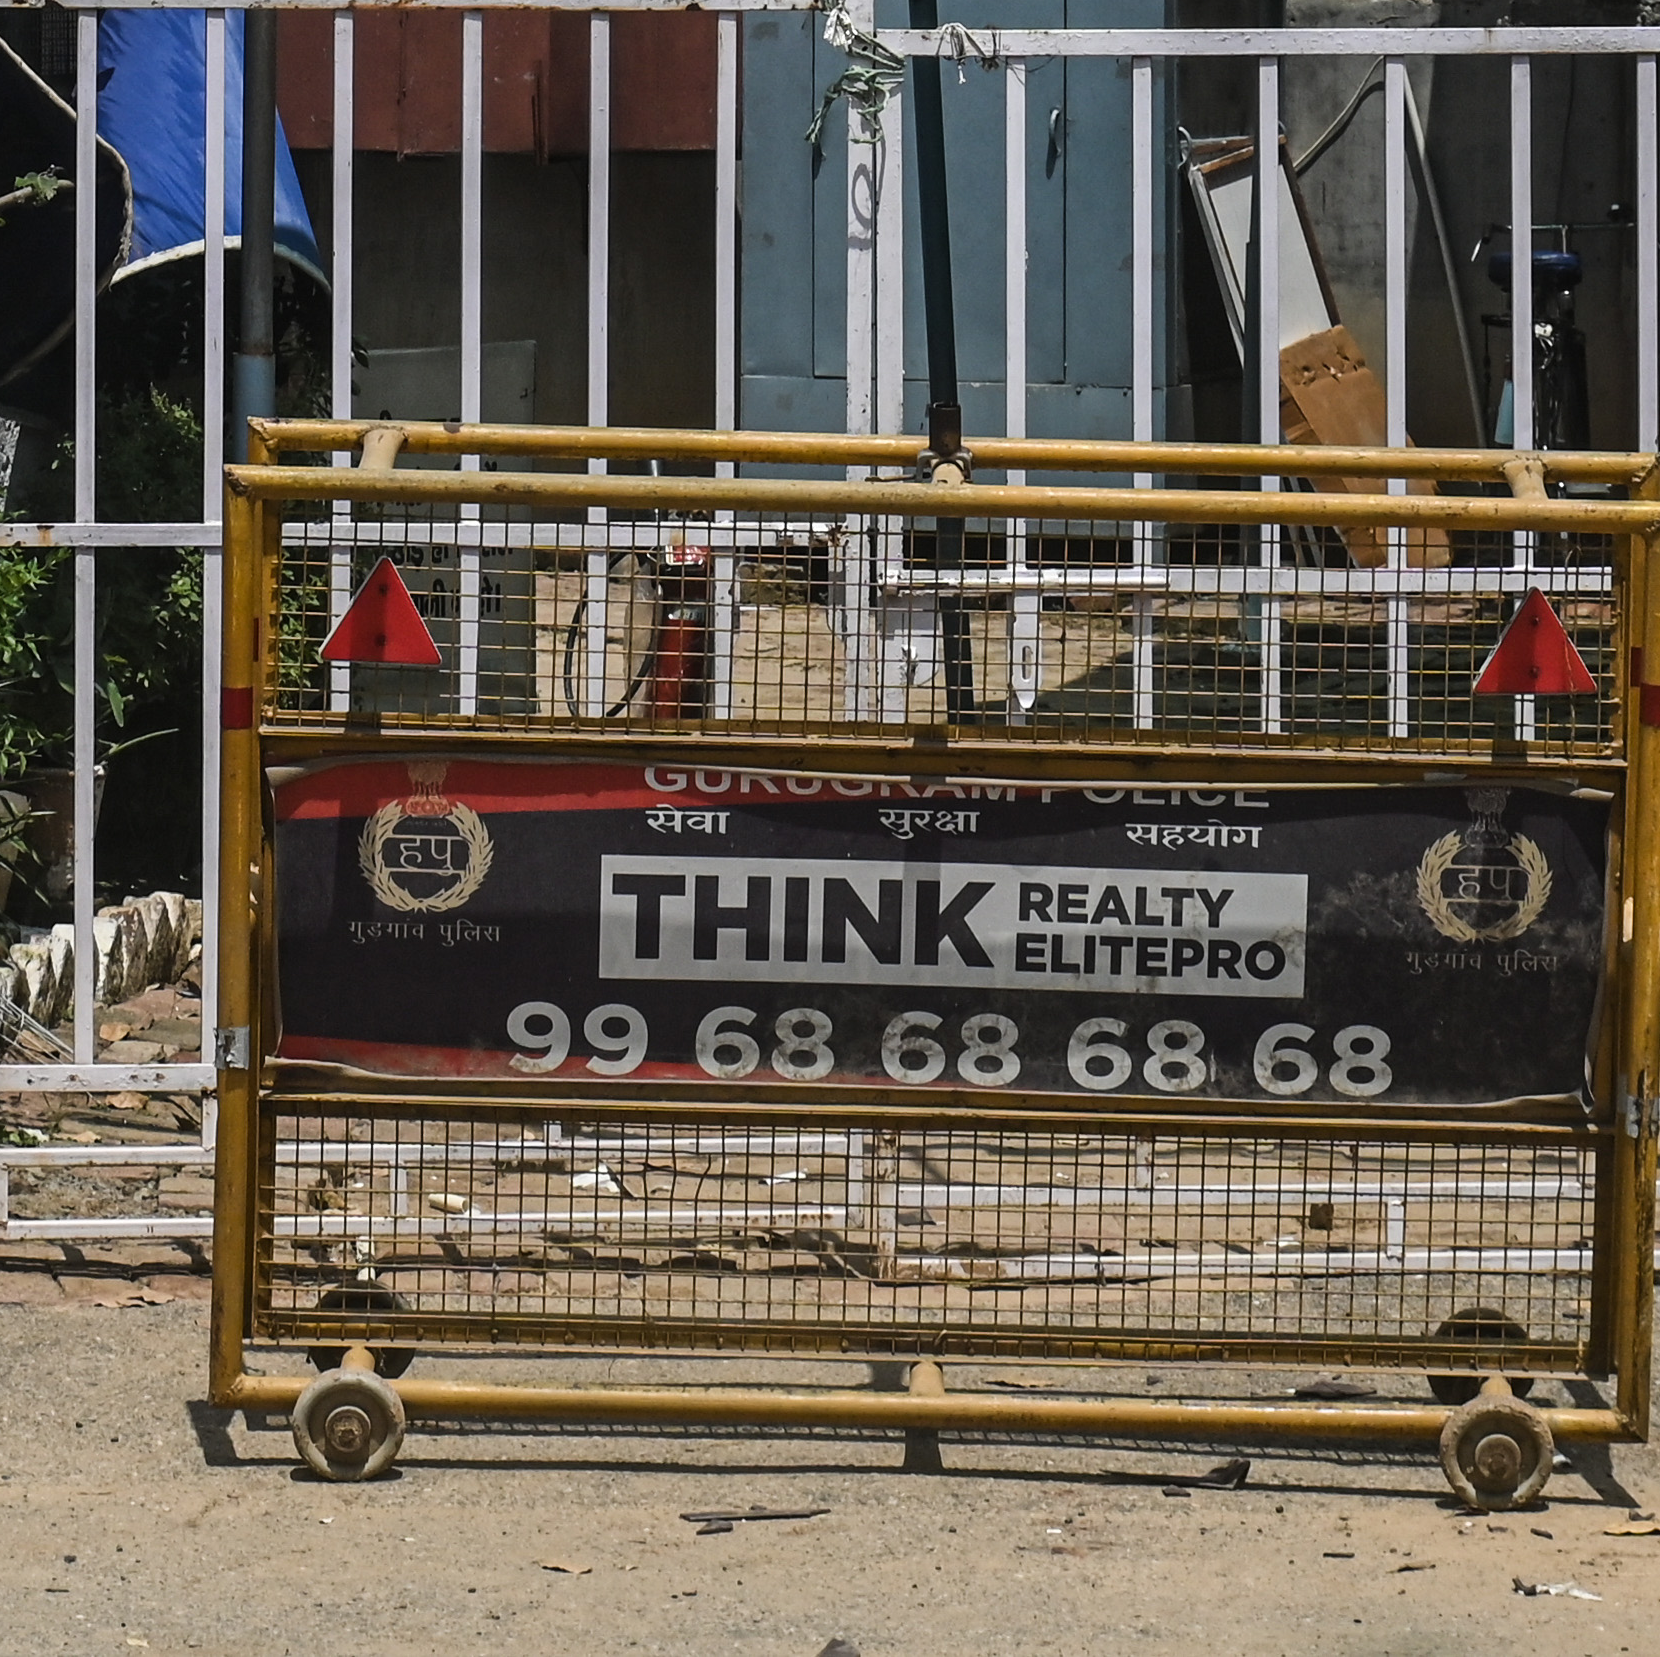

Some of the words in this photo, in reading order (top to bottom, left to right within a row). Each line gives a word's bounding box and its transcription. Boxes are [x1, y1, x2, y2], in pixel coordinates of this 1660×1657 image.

[645, 804, 730, 835] सेवा
[878, 808, 981, 840] सुरक्षा
[1125, 819, 1262, 850] सहयोग
[439, 917, 501, 948] पुलिस
[611, 872, 996, 969] THINK
[1019, 882, 1234, 929] REALTY
[1015, 932, 1287, 982] ELITEPRO
[1497, 948, 1558, 976] पुलिस
[505, 1000, 649, 1076] 99
[695, 1006, 835, 1081] 68
[880, 1010, 1021, 1087] 68
[1066, 1016, 1205, 1093] 68
[1252, 1022, 1394, 1098] 68
